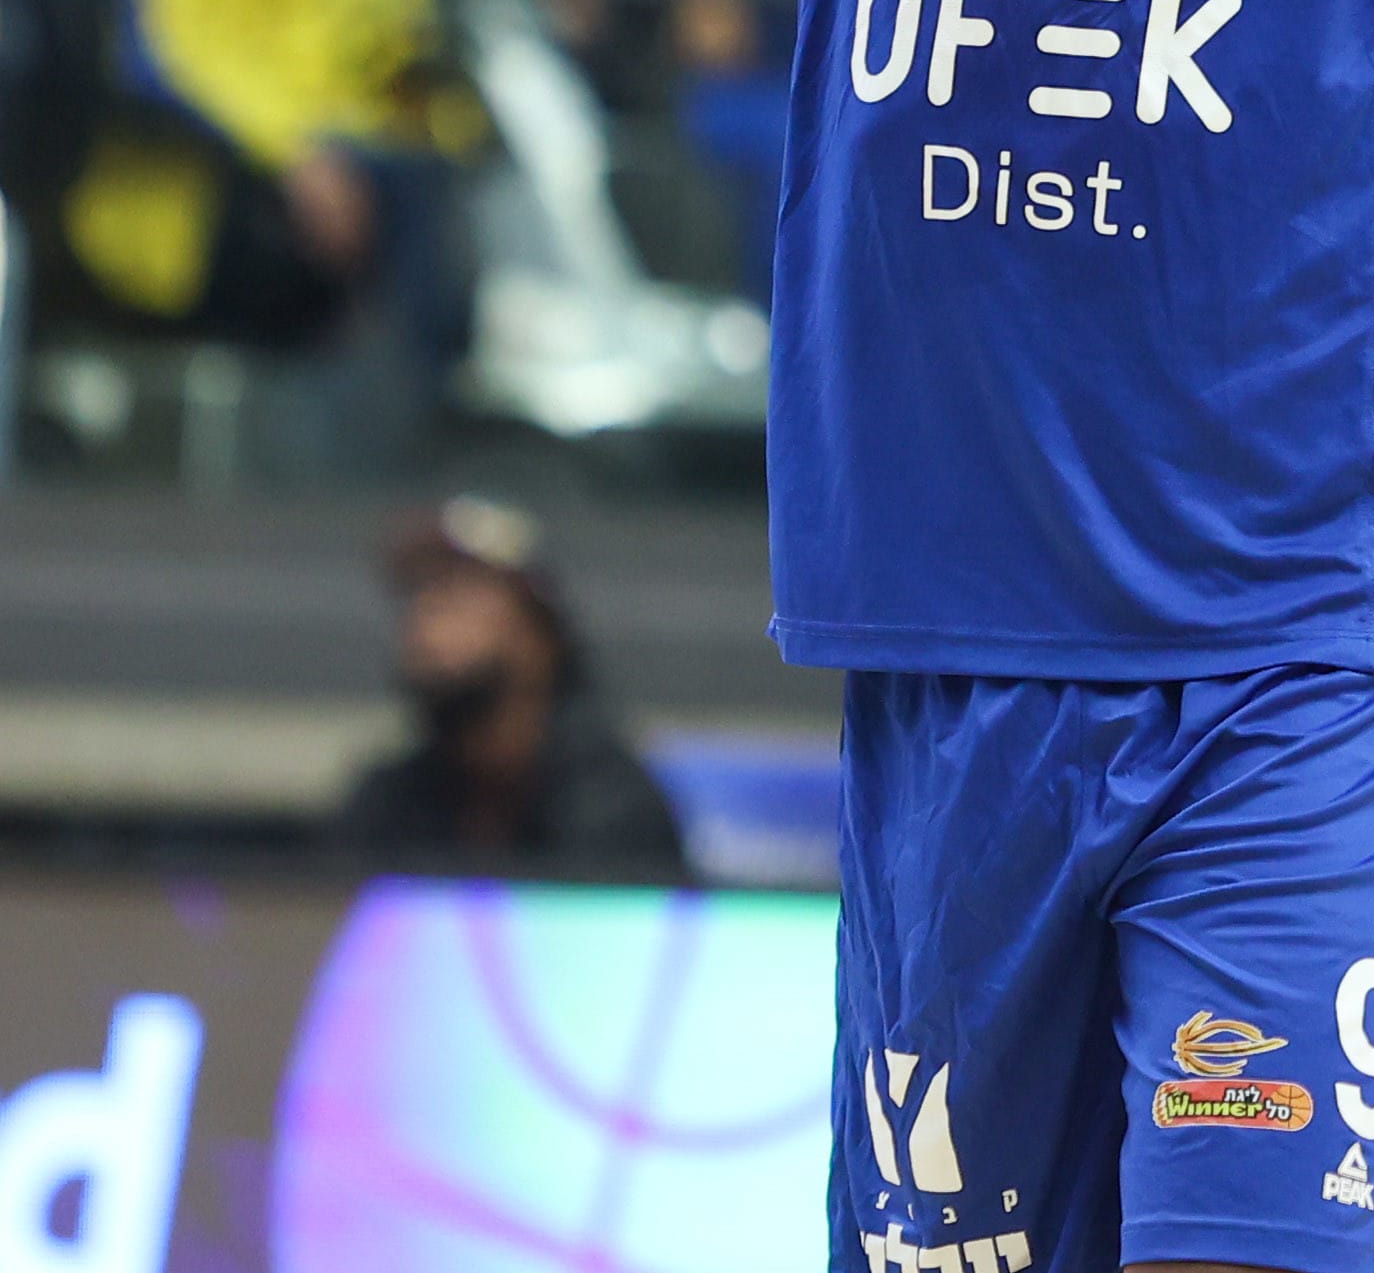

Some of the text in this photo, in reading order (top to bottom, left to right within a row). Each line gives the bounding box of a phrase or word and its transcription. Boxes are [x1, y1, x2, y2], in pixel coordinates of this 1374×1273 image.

[922, 143, 1148, 240] Dist.
[1225, 1085, 1261, 1103] ליגת
[1266, 1099, 1291, 1120] סל
[1322, 1172, 1374, 1211] PEAK
